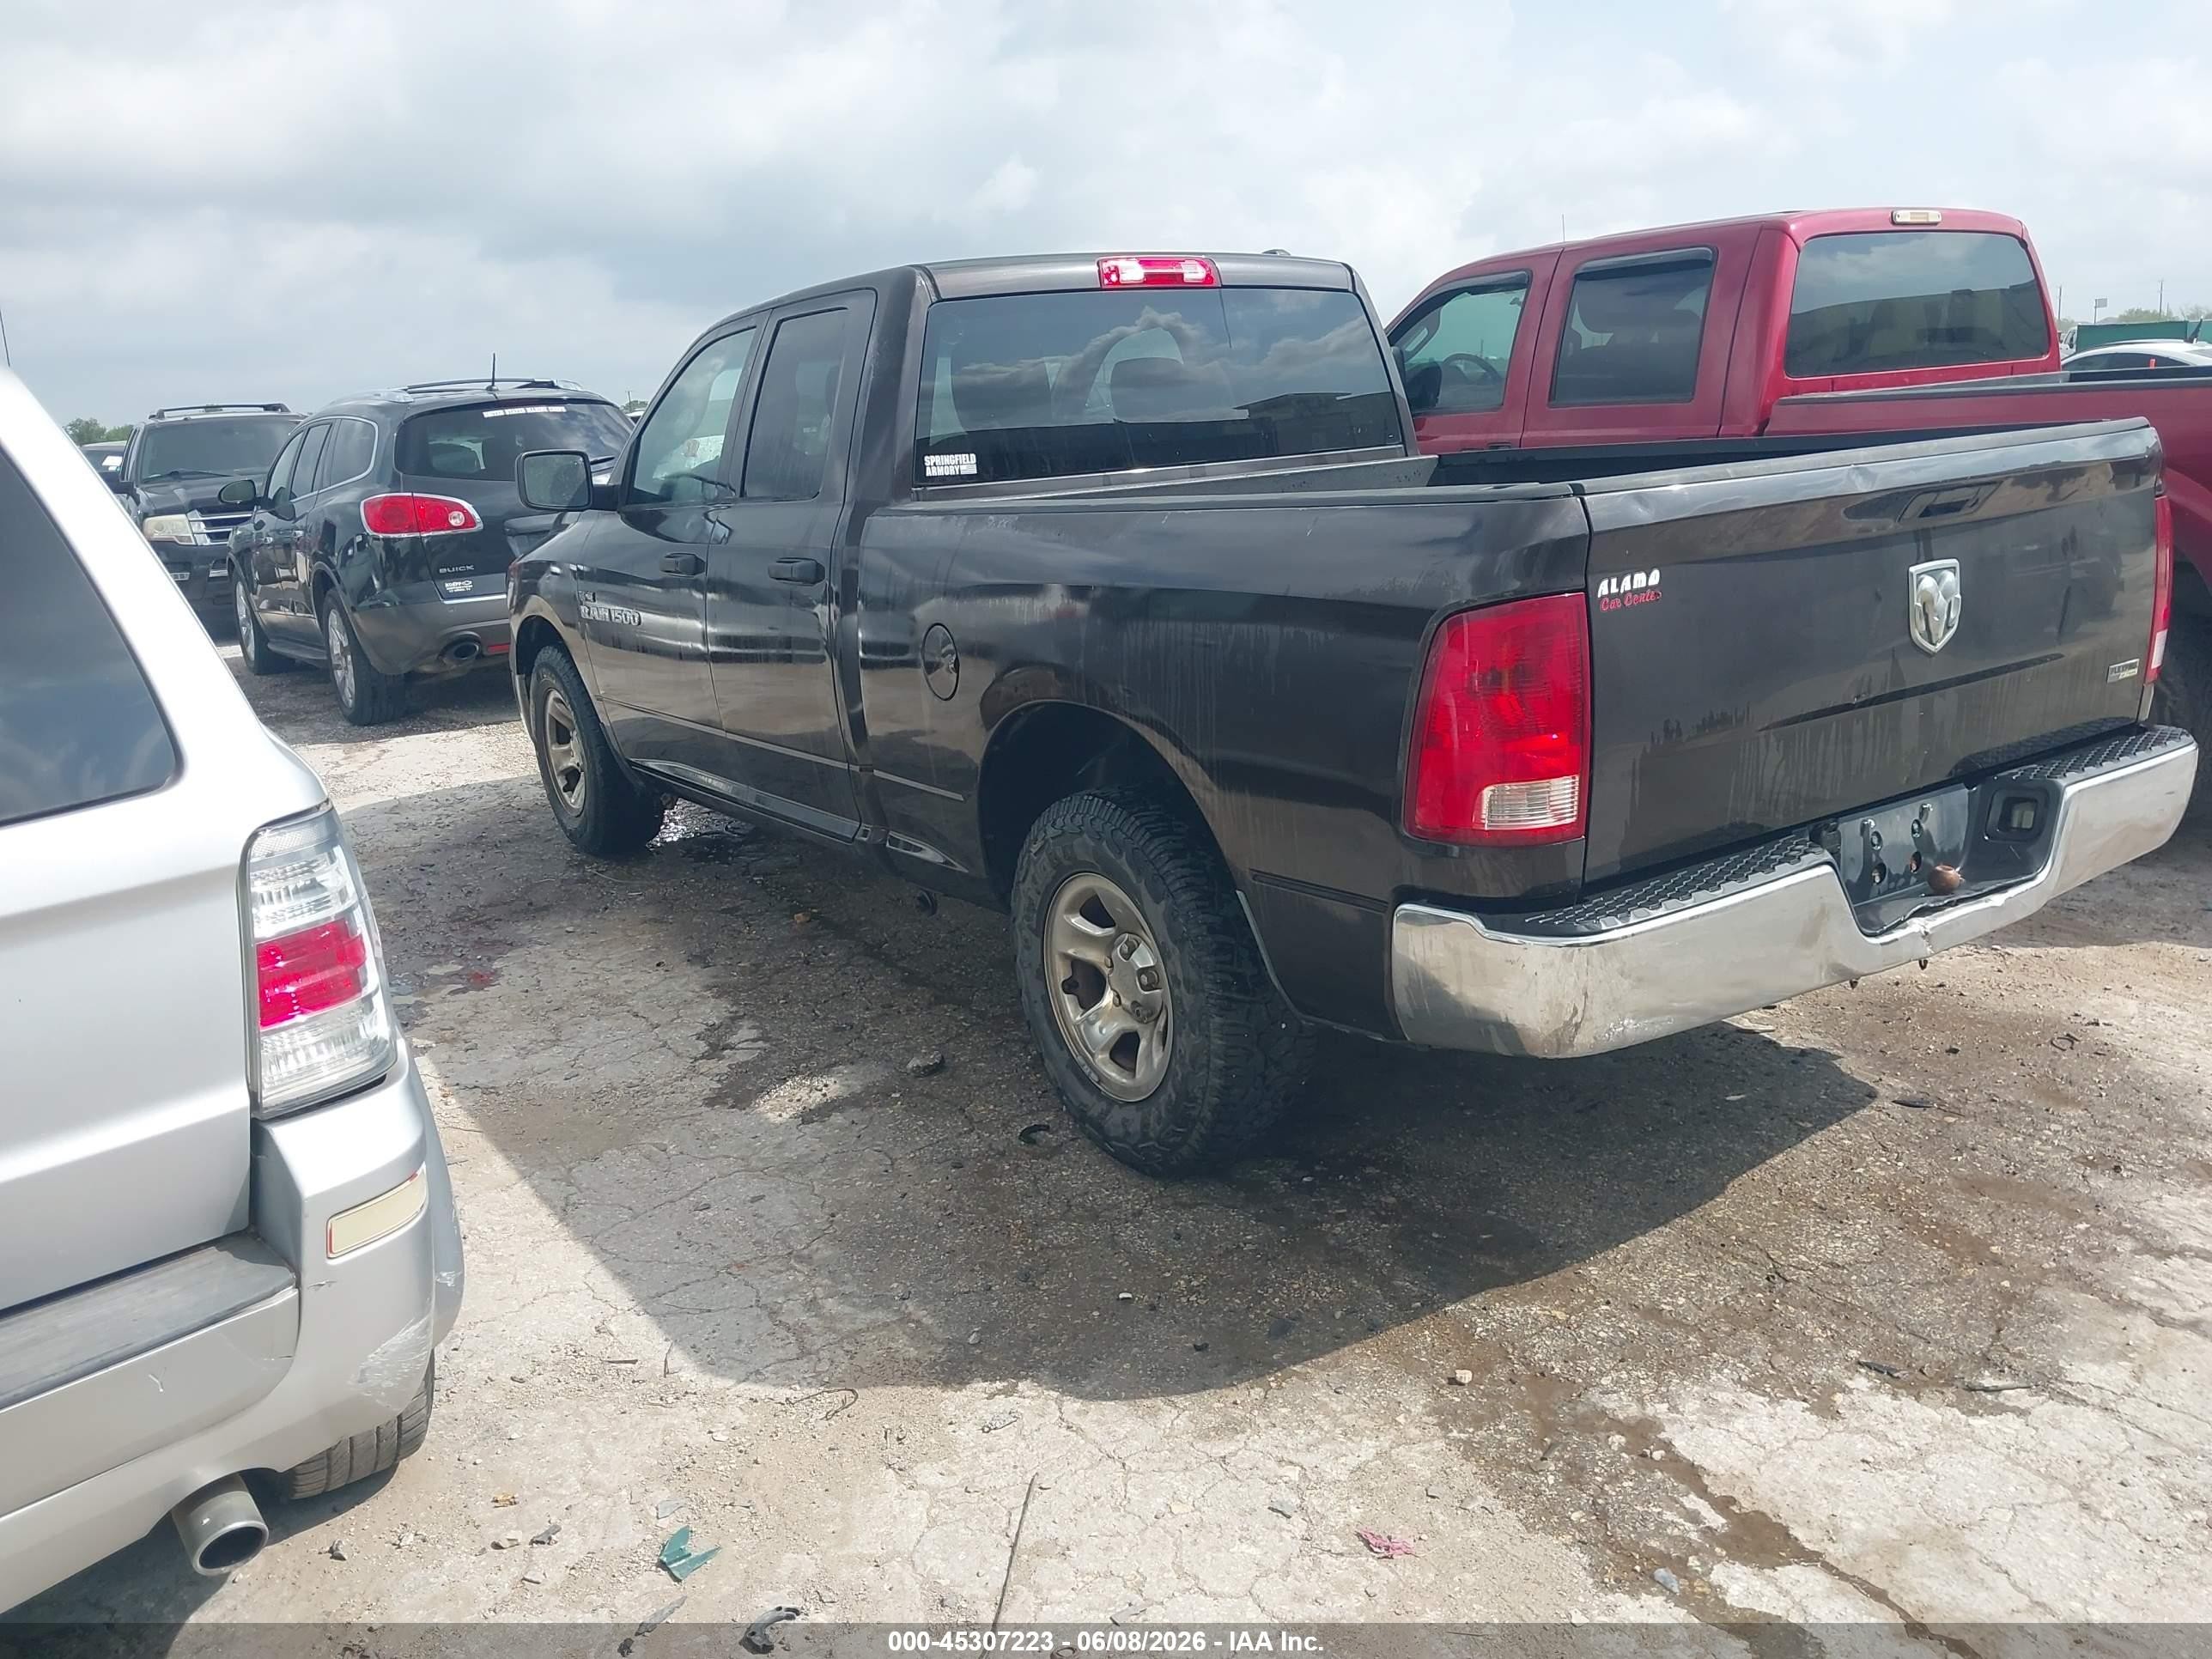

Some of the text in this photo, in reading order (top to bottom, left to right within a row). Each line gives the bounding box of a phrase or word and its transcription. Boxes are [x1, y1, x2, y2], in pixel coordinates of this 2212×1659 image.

[924, 453, 976, 466] SPRINGFIELD
[926, 465, 960, 477] ARMORY
[439, 564, 475, 574] BUICK
[1597, 568, 1661, 599] ALAMO
[580, 605, 641, 626] RAM 1500
